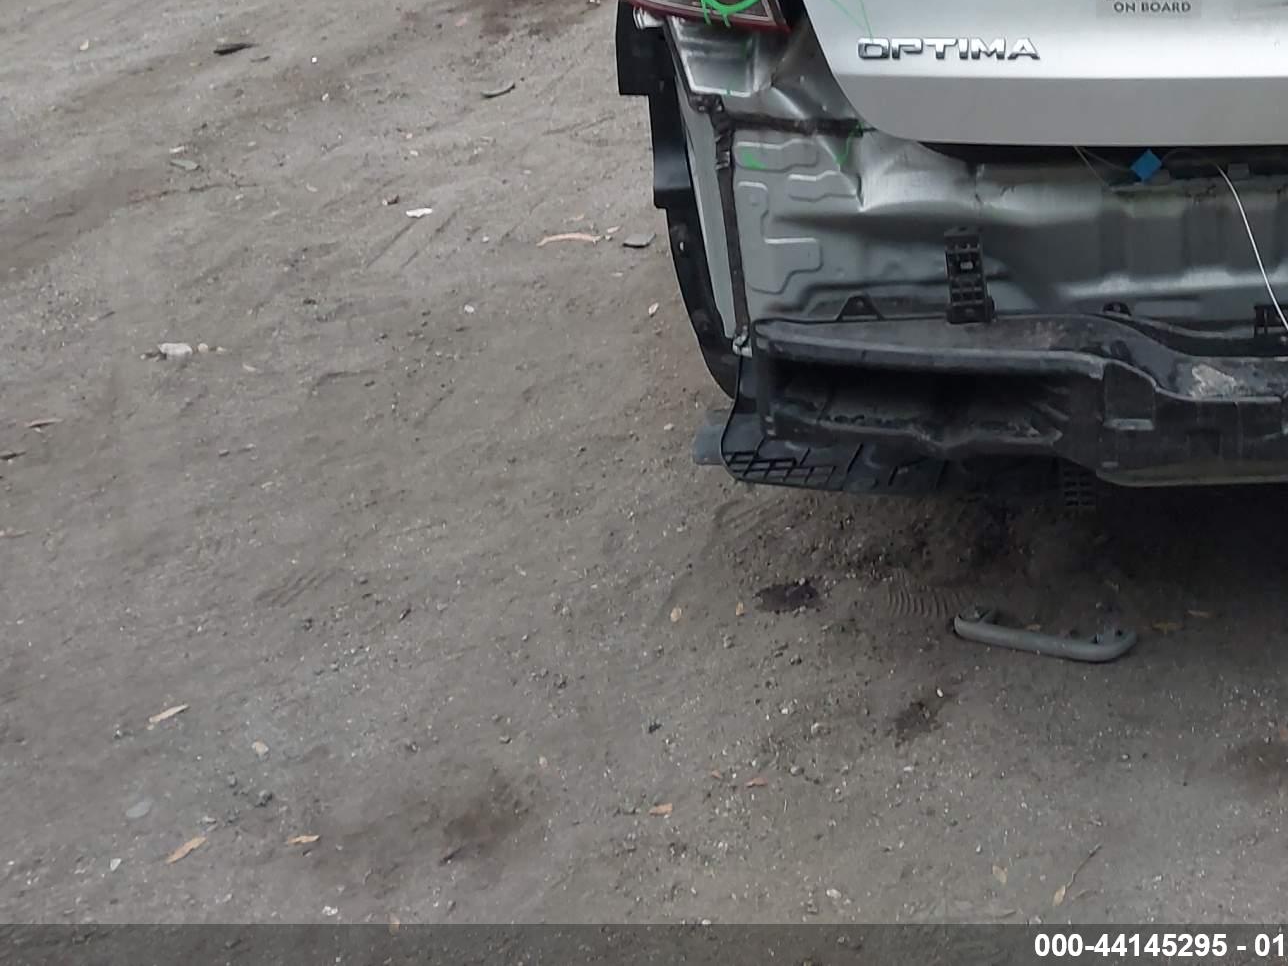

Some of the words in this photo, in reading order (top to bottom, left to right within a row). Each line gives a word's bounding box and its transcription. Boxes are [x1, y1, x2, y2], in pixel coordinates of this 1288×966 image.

[1114, 2, 1136, 12] ON
[1141, 2, 1191, 12] BOARD
[857, 37, 1041, 60] OPTIMA
